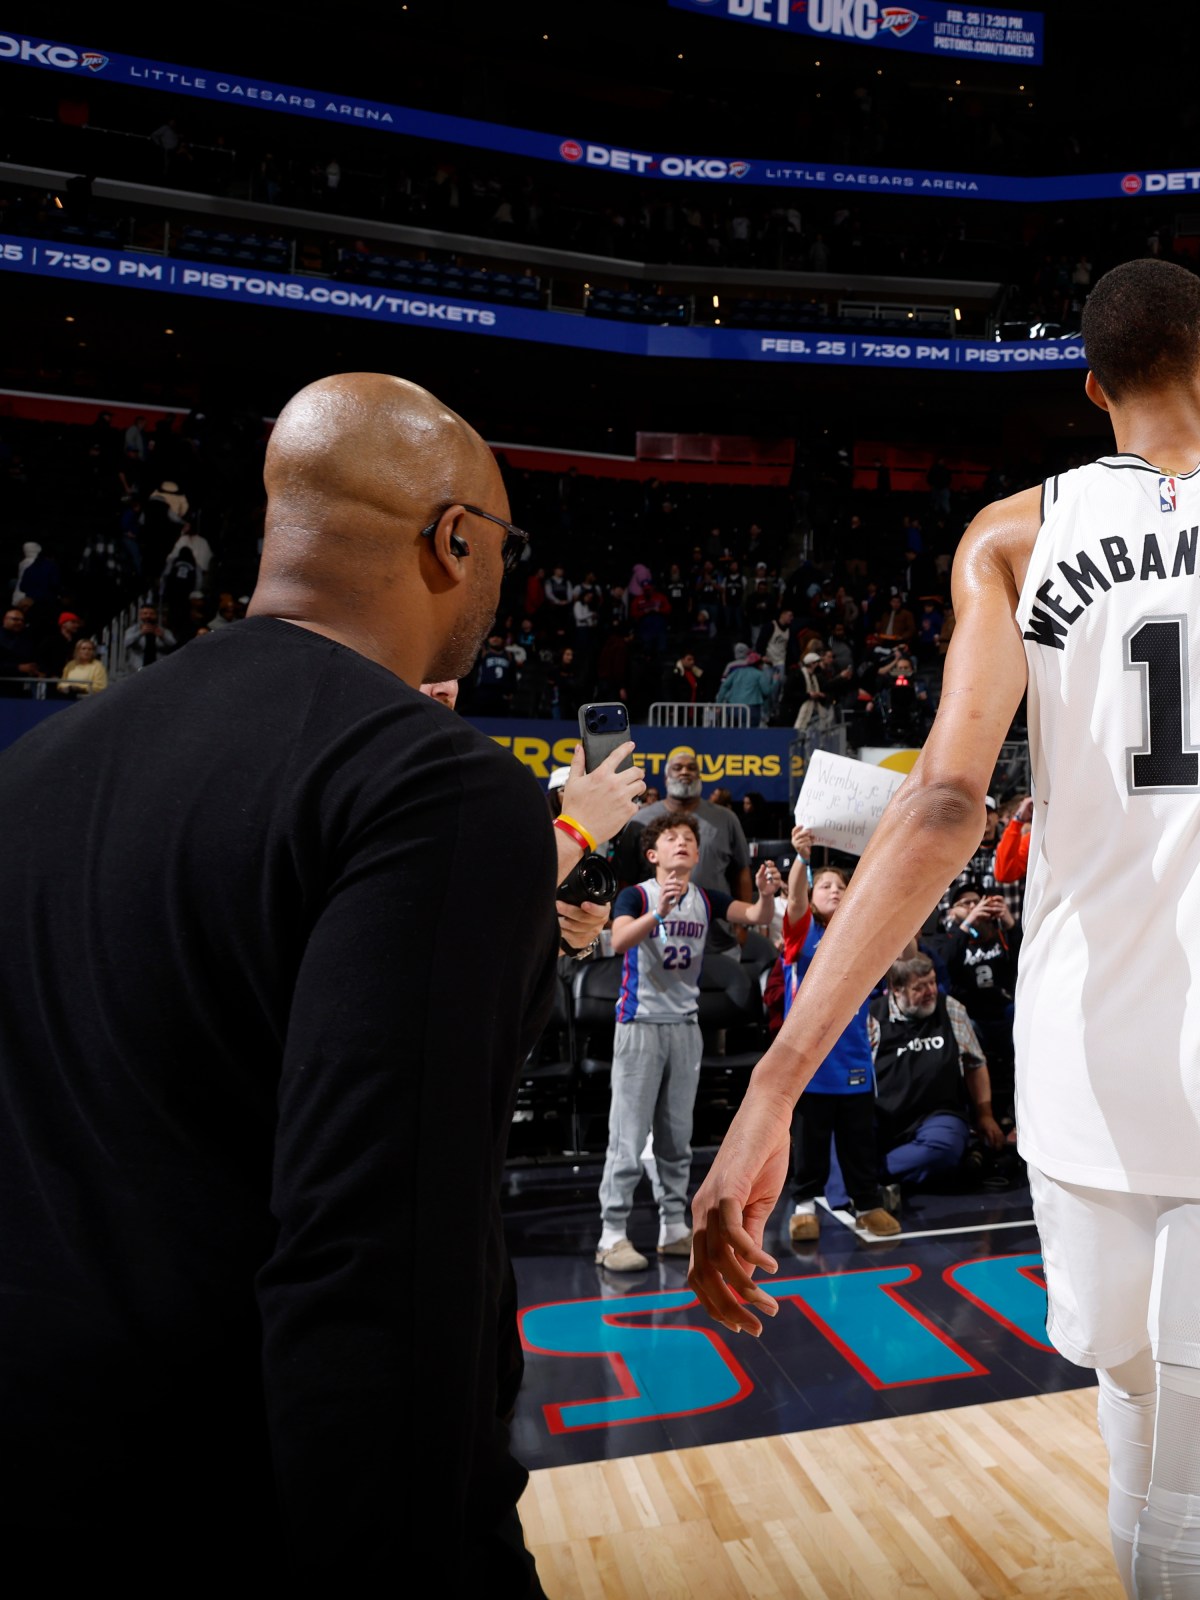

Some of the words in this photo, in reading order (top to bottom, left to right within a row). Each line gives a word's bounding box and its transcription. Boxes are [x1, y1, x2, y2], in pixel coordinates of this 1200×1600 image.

[806, 0, 878, 40] OKC
[946, 10, 965, 23] FEB.
[967, 12, 980, 26] 25
[987, 14, 1008, 29] 7:30
[1008, 16, 1023, 30] PM
[934, 22, 961, 37] LITTLE
[962, 25, 1004, 41] CAESARS
[1005, 30, 1035, 44] ARENA
[0, 35, 79, 69] OKC
[934, 36, 1034, 58] PISTONS.COM/TICKETS
[130, 66, 206, 89] LITTLE
[216, 82, 316, 109] CAESARS
[325, 102, 393, 123] ARENA
[586, 145, 652, 173] DET
[660, 157, 727, 179] OKC
[765, 169, 826, 181] LITTLE
[832, 172, 914, 187] CAESARS
[921, 178, 978, 190] ARENA
[0, 243, 23, 261] 5
[45, 249, 111, 273] 7:30
[118, 260, 162, 280] PM
[183, 269, 496, 326] PISTONS.COM/TICKETS
[761, 338, 810, 354] FEB.
[816, 340, 846, 356] 25
[861, 343, 911, 359] 7:30
[916, 346, 950, 361] PM
[490, 736, 583, 778] RS
[632, 746, 782, 783] ETIVERS
[824, 818, 867, 838] maillot
[649, 920, 705, 939] DETROIT
[663, 945, 692, 971] 23
[975, 964, 994, 988] 2
